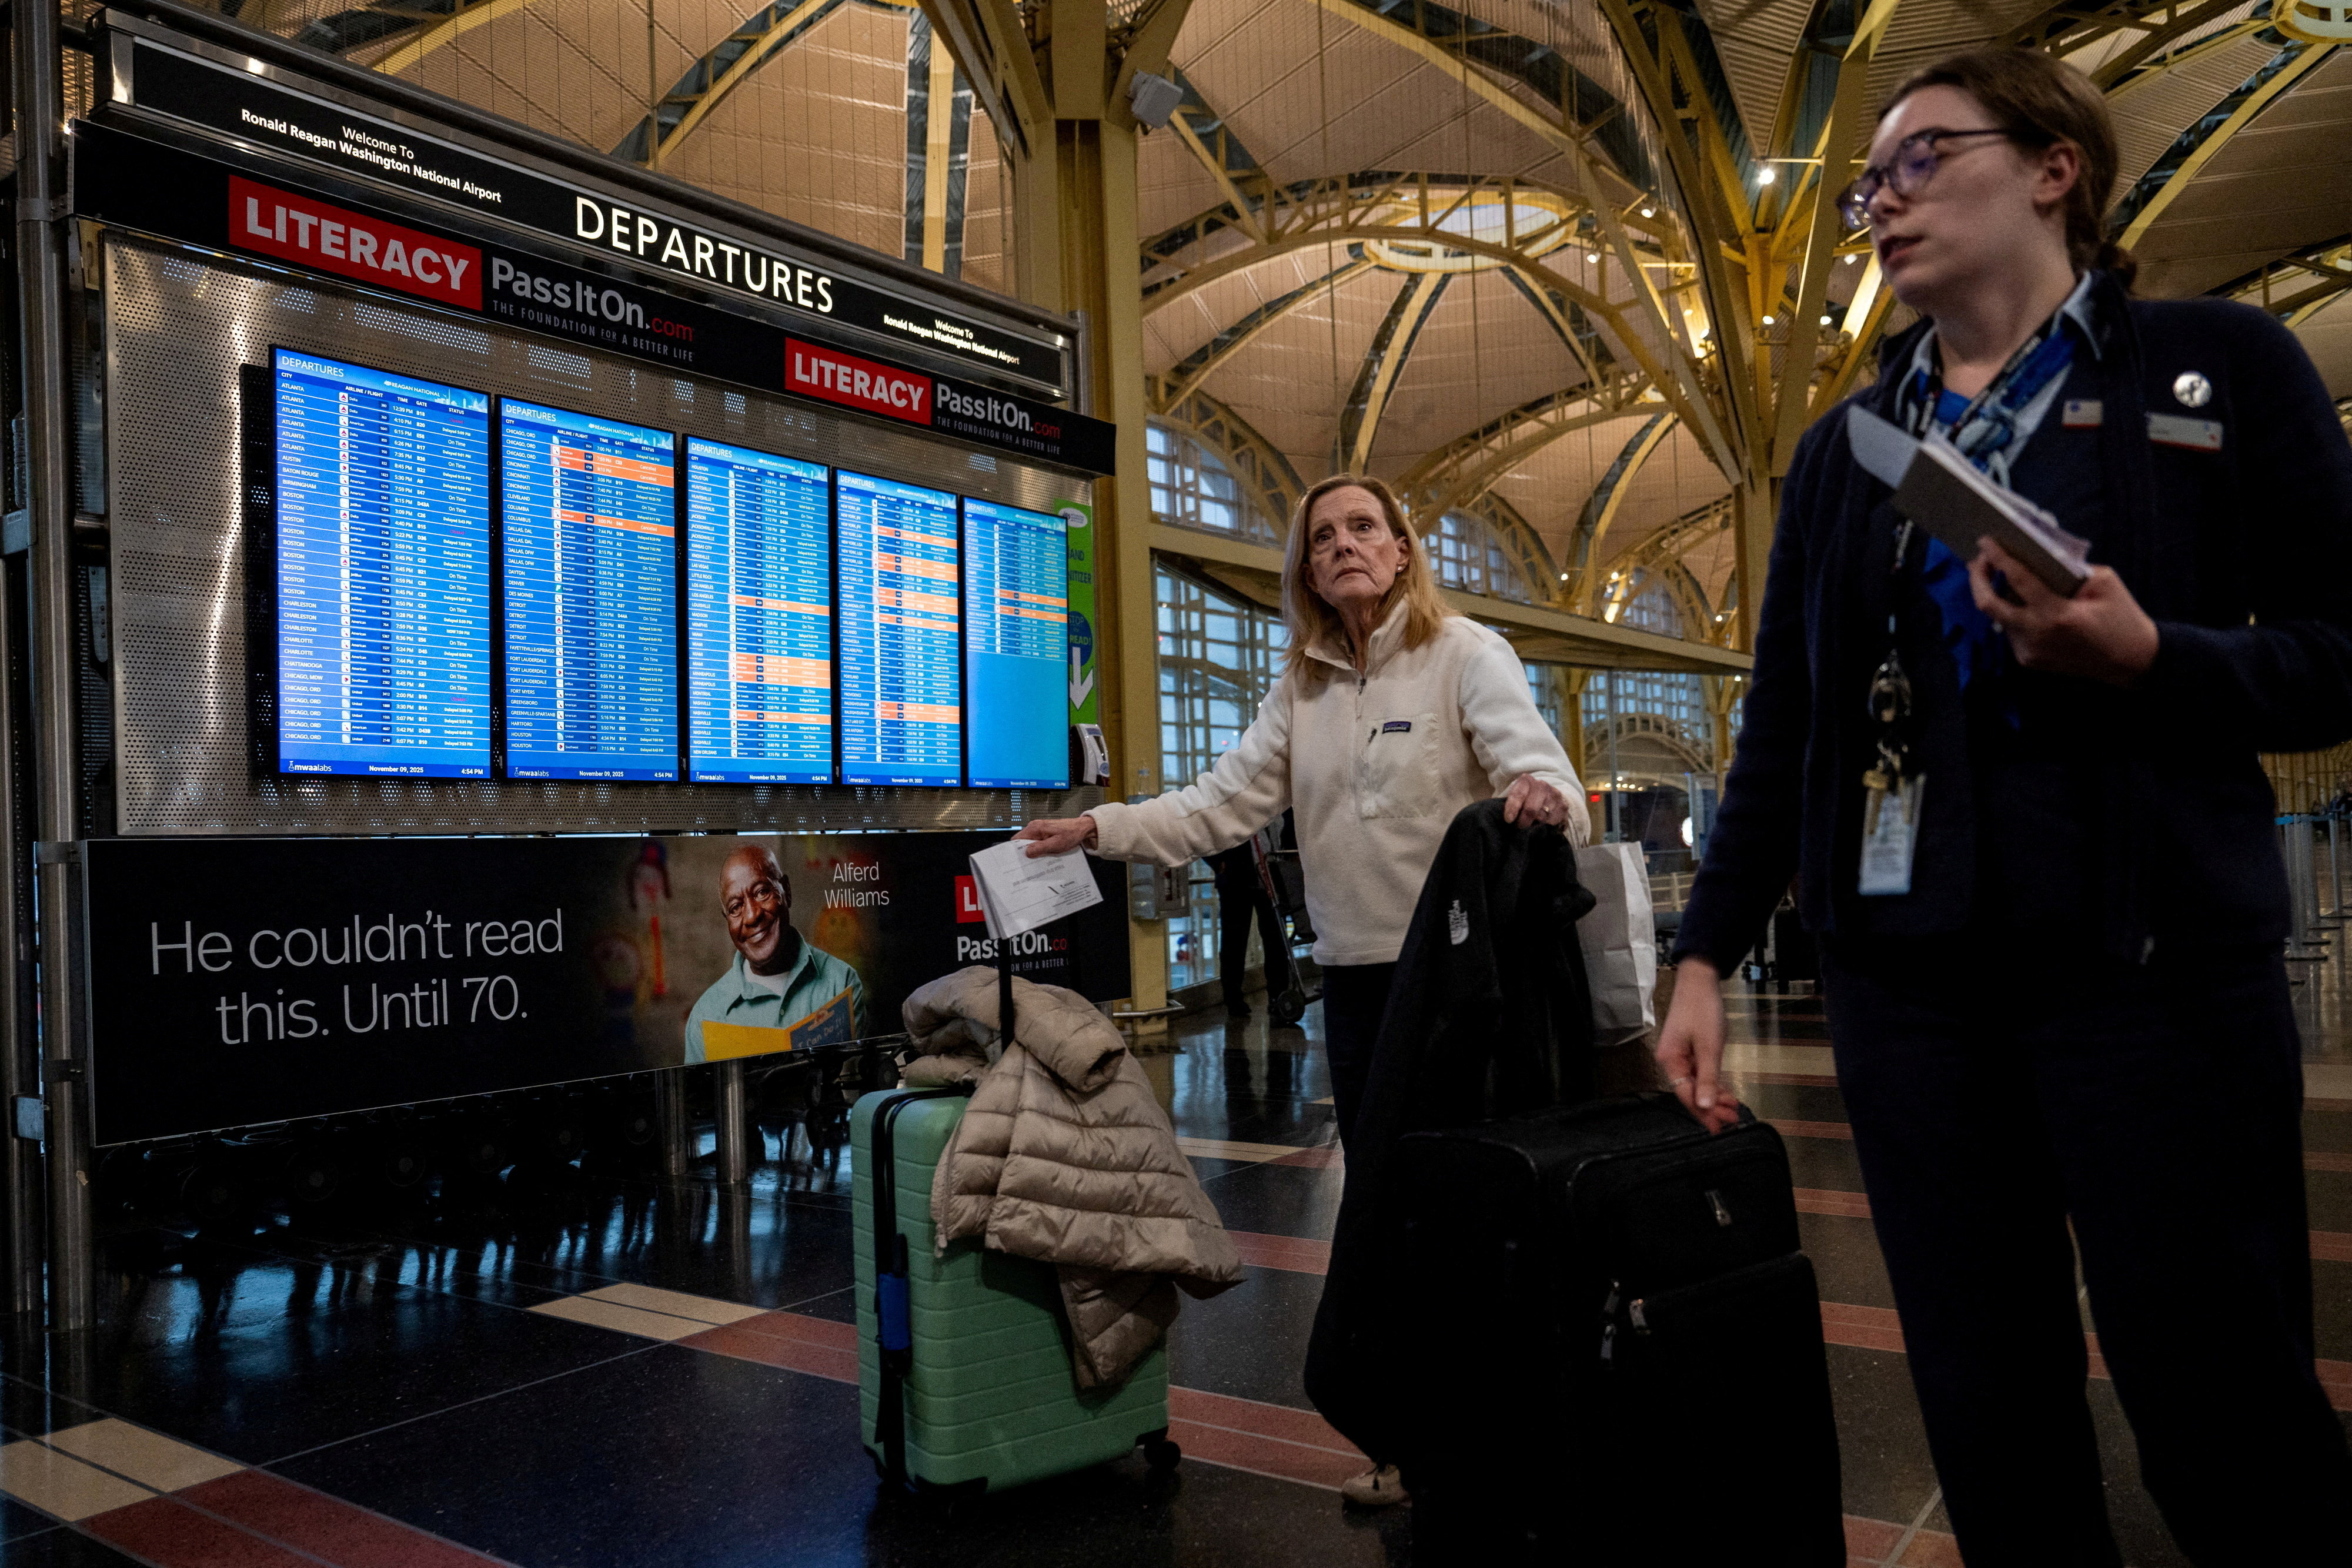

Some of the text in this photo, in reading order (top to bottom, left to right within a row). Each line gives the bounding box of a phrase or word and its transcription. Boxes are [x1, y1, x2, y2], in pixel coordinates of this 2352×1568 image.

[342, 126, 413, 159] Welcome To
[242, 109, 501, 202] Ronald Reagan Washington National Airport
[247, 196, 469, 290] LITERACY
[577, 196, 832, 312] DEPARTURES
[493, 258, 693, 342] PassItOn.com
[493, 300, 691, 361] THE FOUNDATION FOR A BETTER LIFE
[935, 319, 973, 339] Welcome To
[884, 315, 1018, 364] Ronald Reagan Washington National Airport
[282, 356, 343, 377] DEPARTURES
[281, 383, 304, 391] ATLANTA
[392, 382, 439, 396] REAGAN NATIONAL
[796, 353, 923, 410] LITERACY
[282, 395, 304, 403] ATLANTA
[282, 407, 304, 415] ATLANTA
[506, 404, 556, 422] DEPARTURES
[937, 383, 1060, 439] PassItOn.com
[281, 431, 305, 439] ATLANTA
[937, 416, 950, 427] THE
[954, 420, 999, 439] FOUNDATION
[1022, 438, 1044, 450] BETTER
[1048, 444, 1059, 454] LIFE
[282, 443, 305, 451] ATLANTA
[691, 443, 731, 457] DEPARTURES
[282, 479, 316, 489] BIRMINGHAM
[840, 475, 874, 488] DEPARTURES
[966, 503, 994, 513] DEPARTURES
[1068, 549, 1084, 561] AND
[1070, 635, 1091, 646] READ!
[833, 862, 878, 882] Alferd
[824, 888, 888, 911] Williams
[152, 908, 562, 974] He couldn't read
[1042, 958, 1064, 968] BETTER
[216, 975, 527, 1044] this. Until 70.
